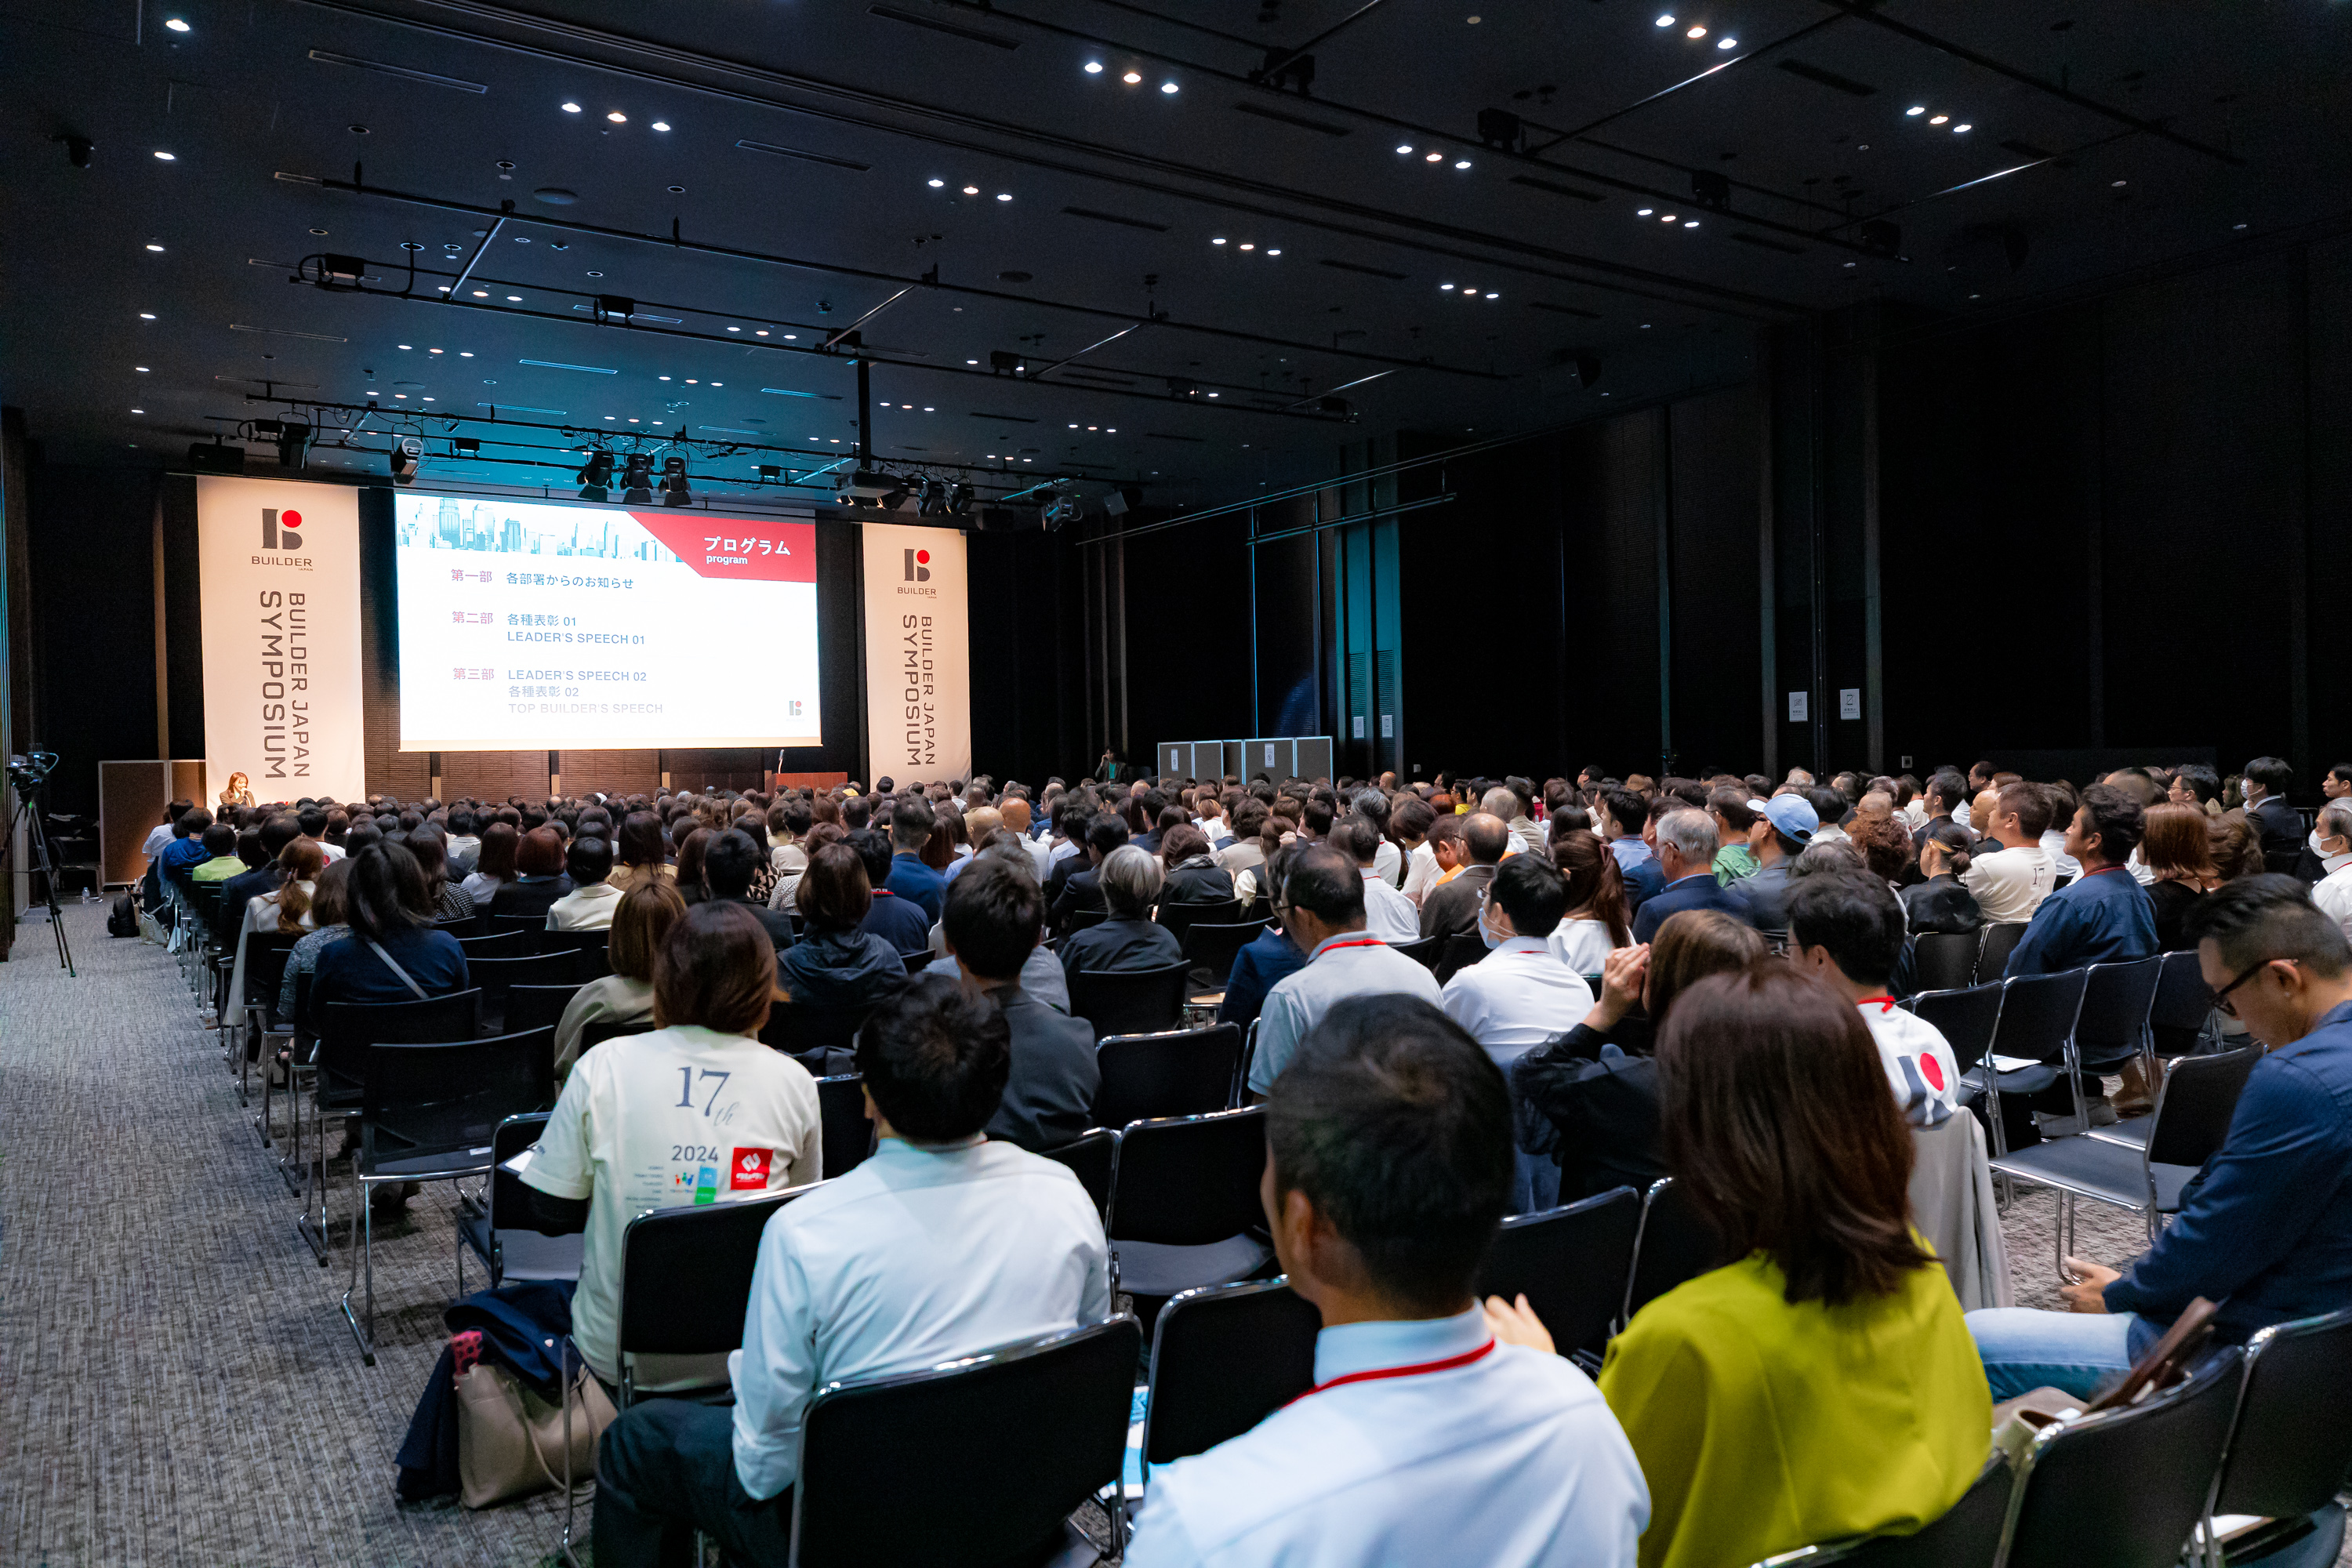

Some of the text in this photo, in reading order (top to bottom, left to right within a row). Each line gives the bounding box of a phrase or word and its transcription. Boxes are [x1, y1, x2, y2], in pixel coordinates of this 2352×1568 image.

[704, 535, 791, 556] プログラム
[251, 556, 312, 567] BUILDER
[706, 555, 748, 565] program
[451, 568, 492, 583] 第一部
[506, 572, 633, 589] 各部署からのお知らせ
[897, 586, 936, 595] BUILDER
[452, 611, 493, 624] 第二部
[507, 613, 576, 626] 各種表彰 01
[507, 631, 645, 644] LEADER'S SPEECH 01
[452, 667, 495, 681] 第三部
[508, 670, 647, 681] LEADER'S SPEECH 02
[260, 590, 287, 779] SYMPOSIUM
[289, 592, 310, 777] BUILDER JAPAN
[508, 685, 579, 698] 各種表彰 02
[902, 614, 921, 766] SYMPOSIUM
[921, 615, 935, 765] BUILDER JAPAN
[508, 703, 663, 713] TOP BUILDER'S SPEECH
[2032, 867, 2045, 887] 17
[671, 1145, 719, 1162] 2024
